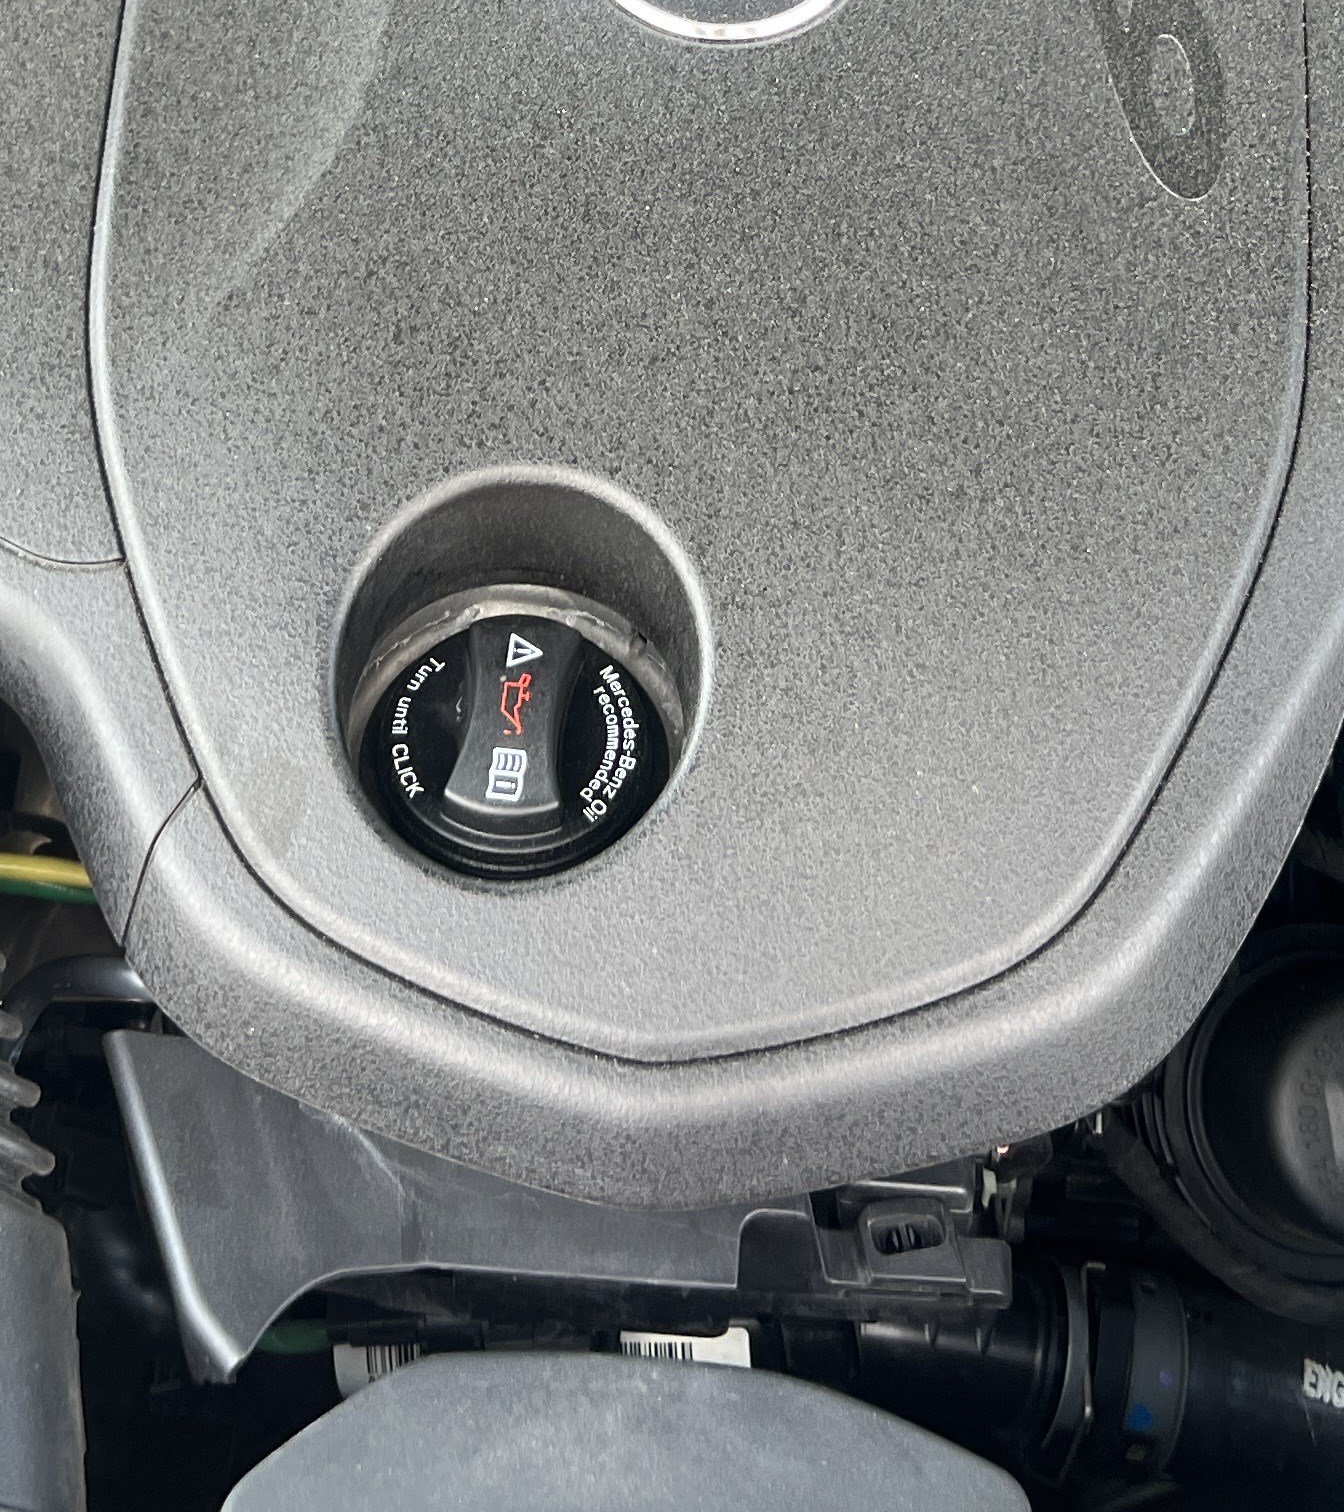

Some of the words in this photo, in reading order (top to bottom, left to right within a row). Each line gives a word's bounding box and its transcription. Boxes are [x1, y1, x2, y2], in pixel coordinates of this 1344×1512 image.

[406, 657, 446, 692] Turn
[391, 696, 412, 736] until
[598, 664, 640, 800] Mercedes-Benz
[579, 685, 620, 803] recommended
[391, 743, 425, 800] CLICK
[582, 799, 608, 823] Oil
